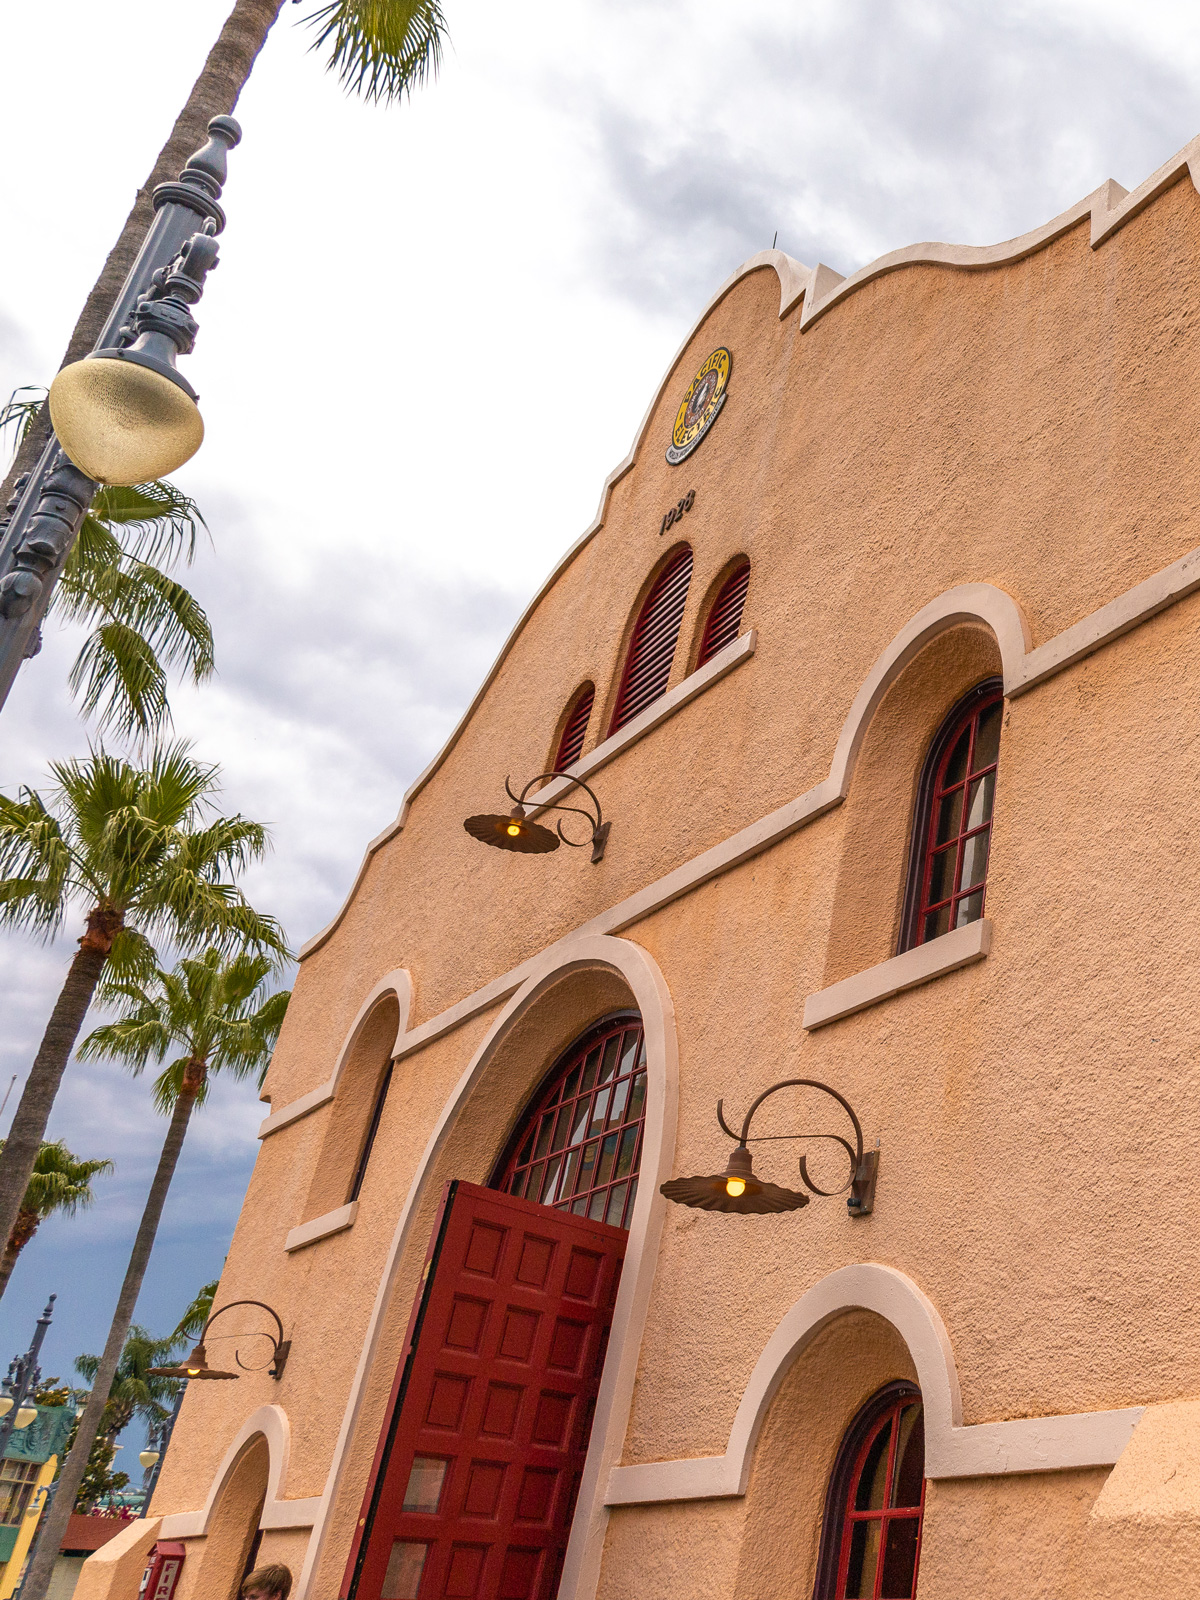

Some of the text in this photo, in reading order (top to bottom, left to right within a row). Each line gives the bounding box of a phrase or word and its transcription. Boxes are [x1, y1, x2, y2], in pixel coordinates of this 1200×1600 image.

[683, 352, 727, 404] PACIFIC
[675, 386, 723, 444] ELECTRIC
[659, 489, 696, 536] 1928
[155, 1562, 177, 1600] FIR
